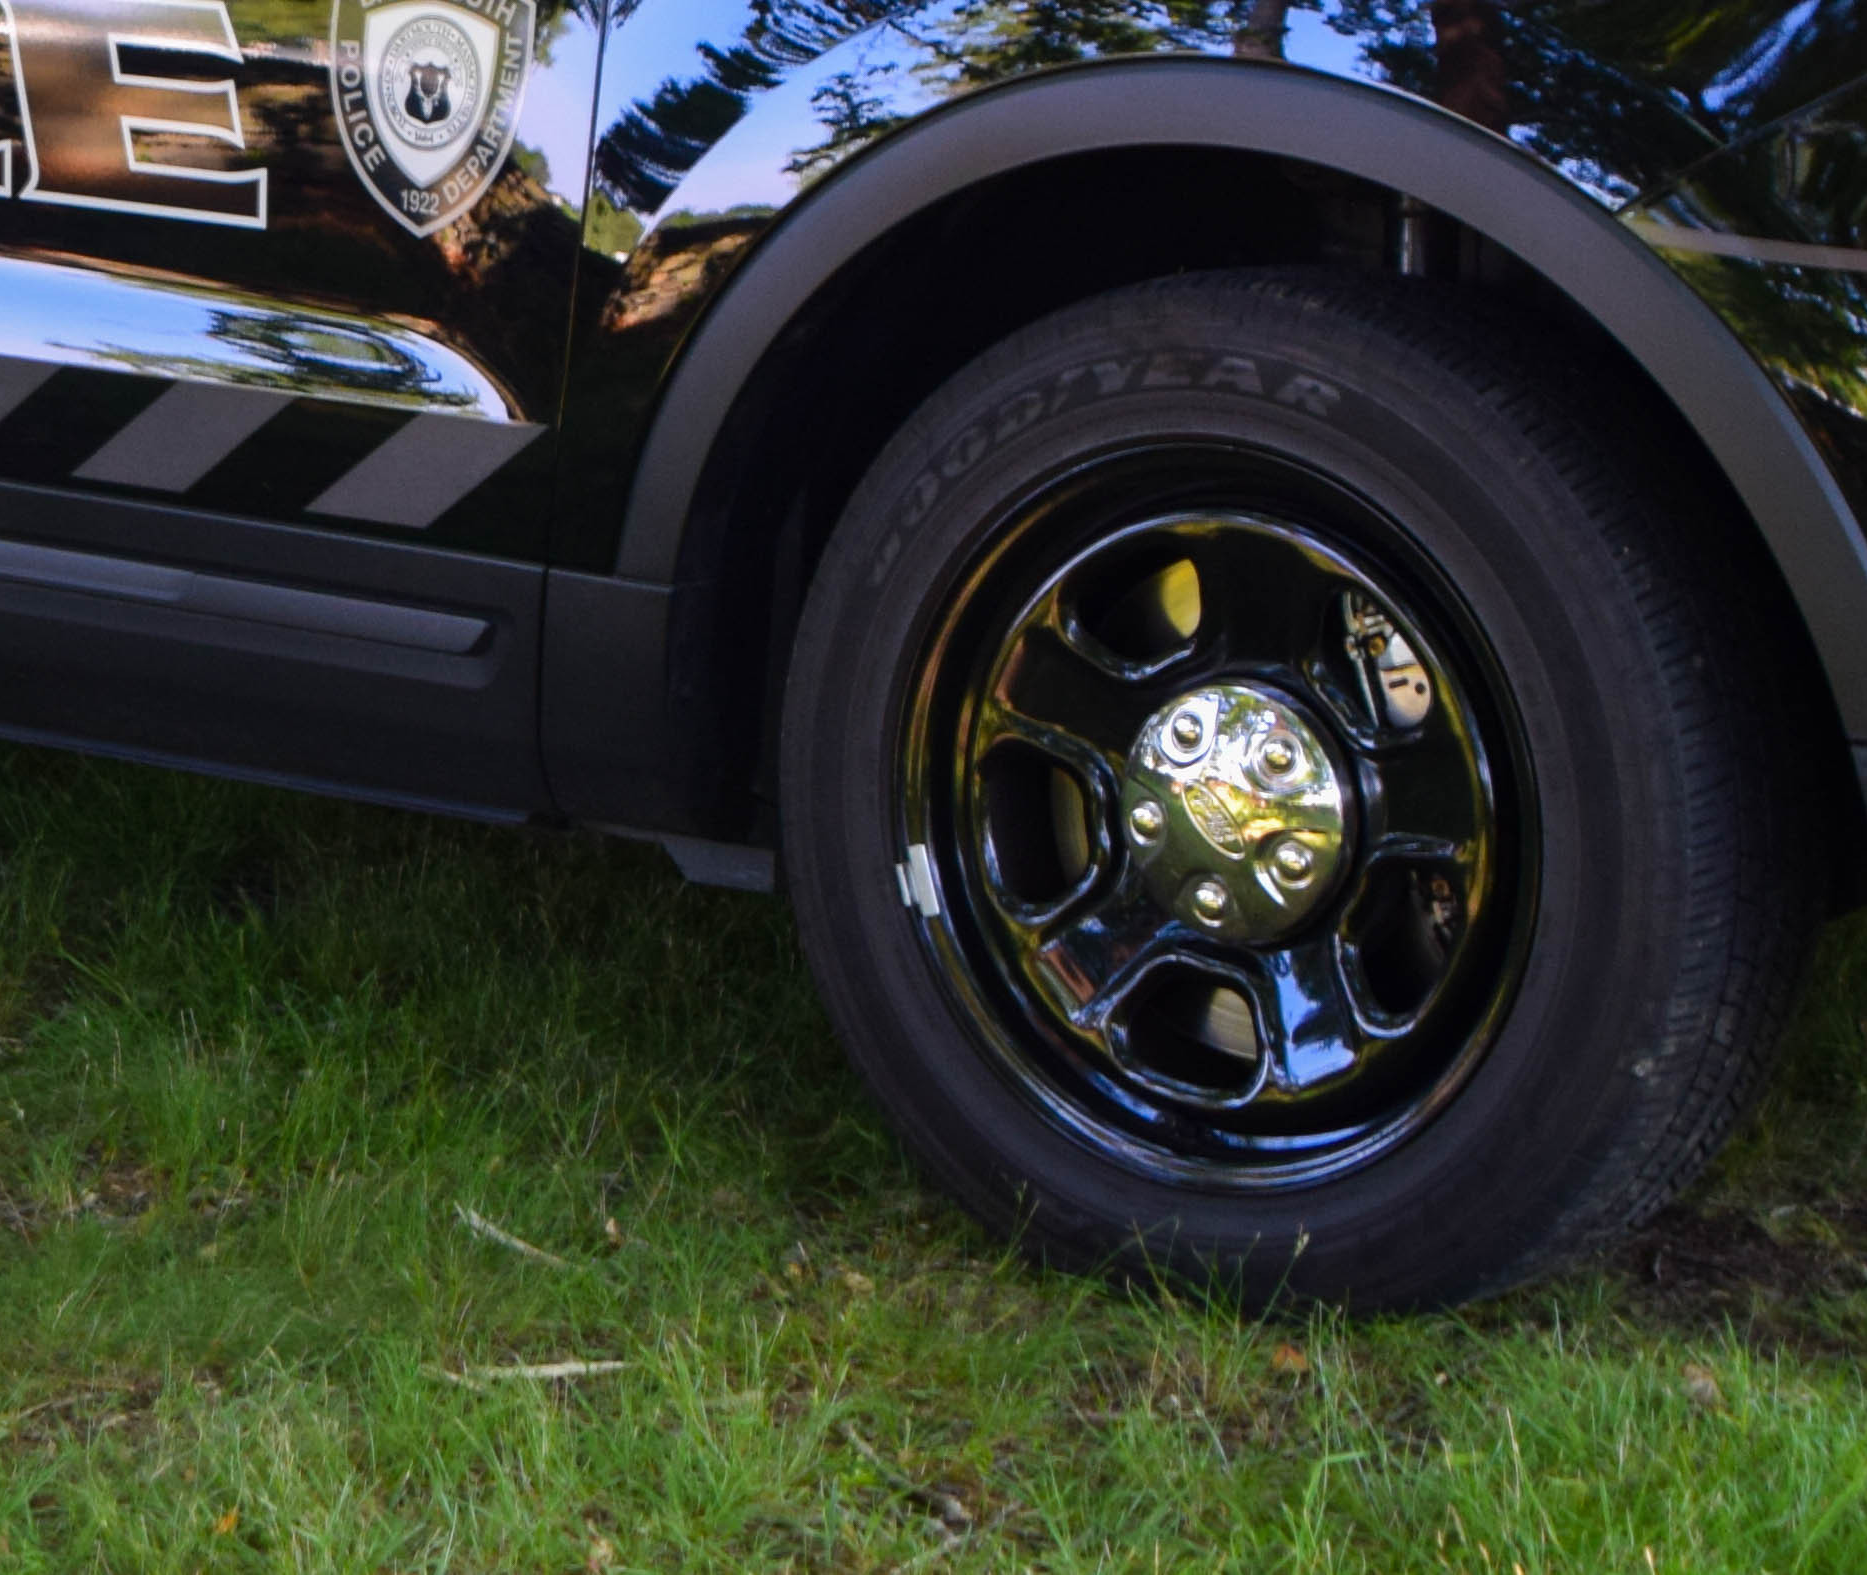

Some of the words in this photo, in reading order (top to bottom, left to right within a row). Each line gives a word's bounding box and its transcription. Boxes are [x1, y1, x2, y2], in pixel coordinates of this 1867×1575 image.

[340, 39, 387, 174] POLICE
[441, 34, 523, 205] DEPARTMENT
[400, 188, 440, 216] 1922
